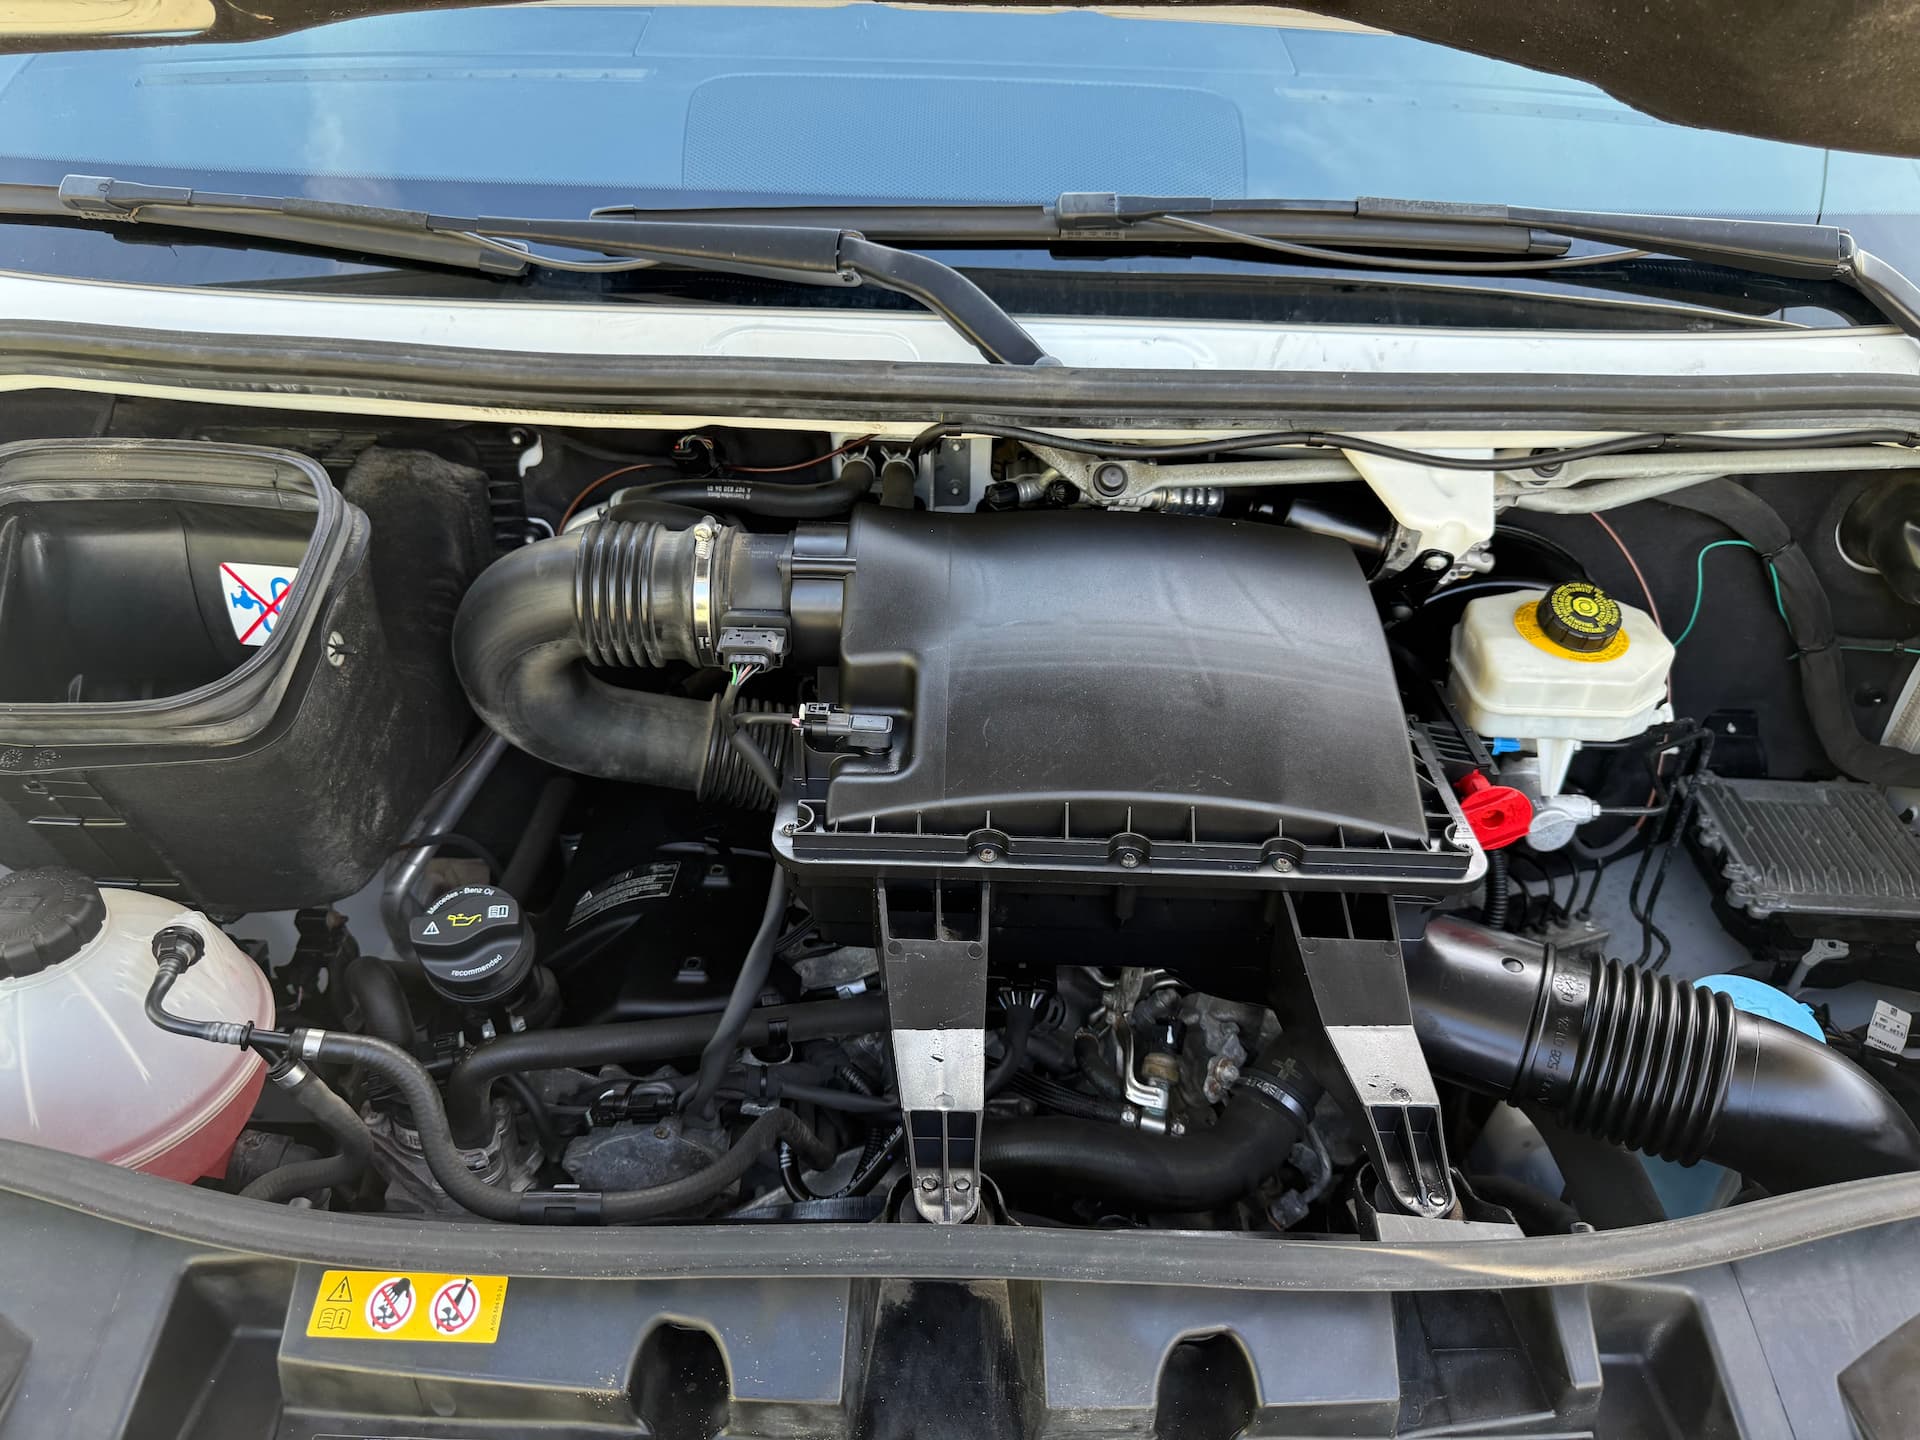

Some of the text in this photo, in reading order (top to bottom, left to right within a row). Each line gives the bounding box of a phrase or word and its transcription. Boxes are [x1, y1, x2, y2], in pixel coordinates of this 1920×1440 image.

[427, 889, 459, 914] Mercedes
[464, 887, 483, 895] Benz
[484, 887, 495, 896] Oil
[451, 954, 503, 977] recommended
[1547, 1049, 1562, 1071] 528
